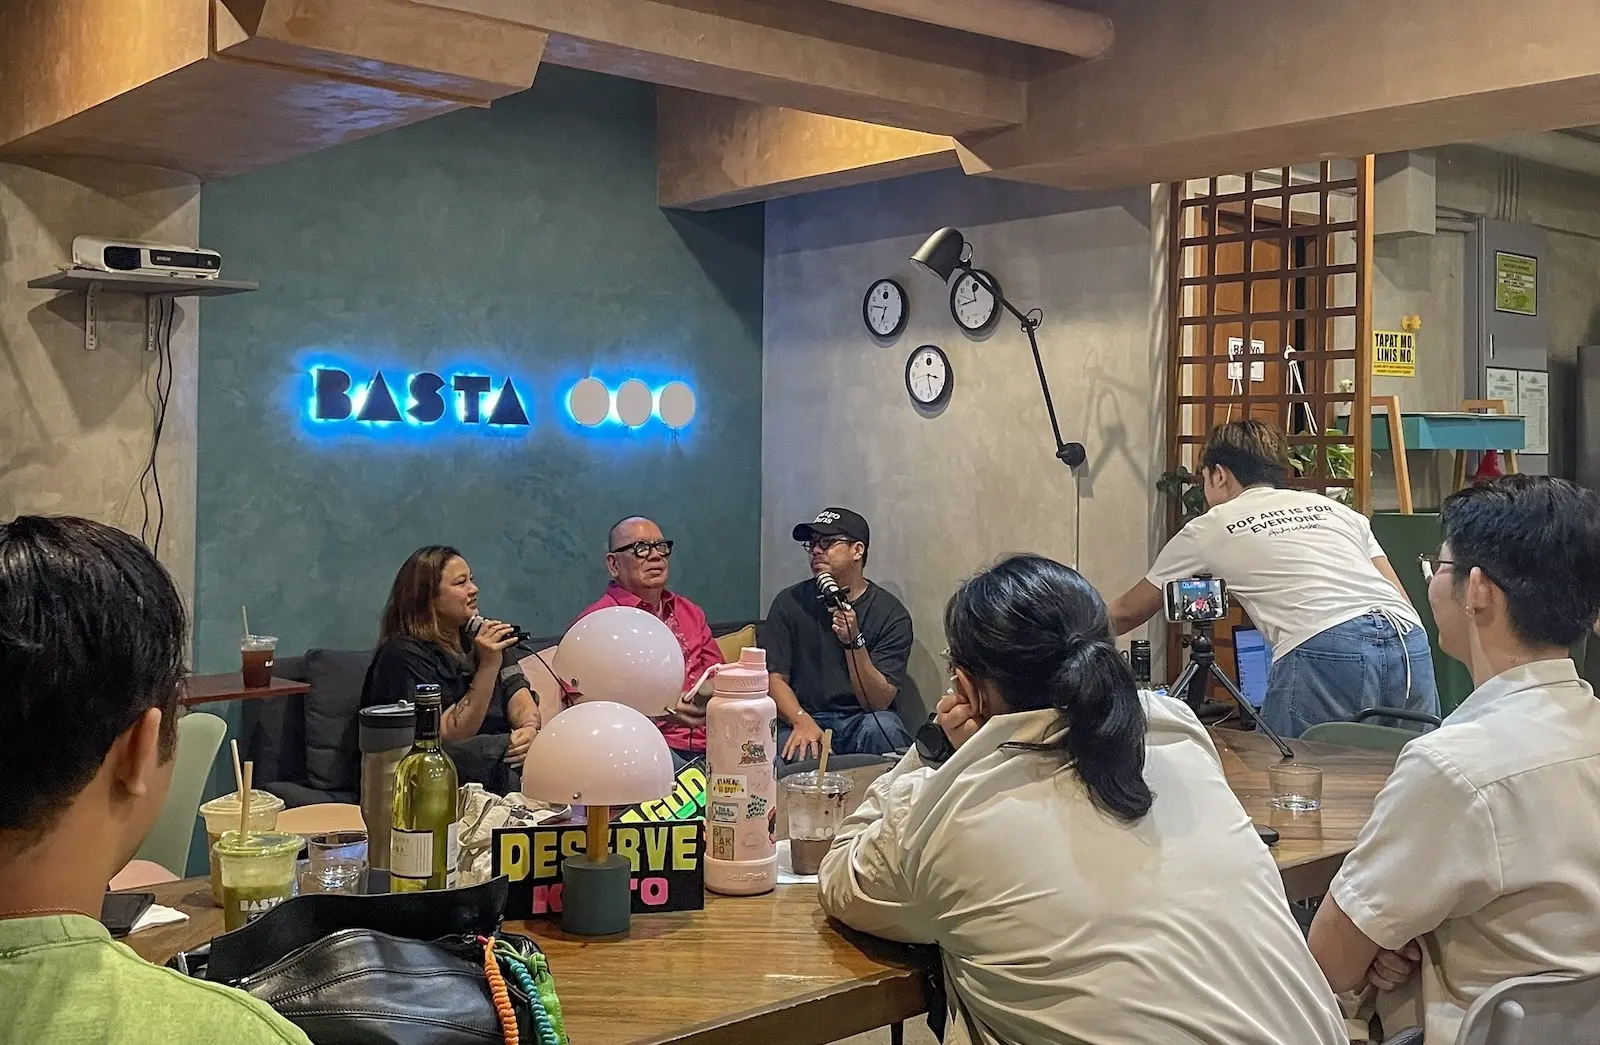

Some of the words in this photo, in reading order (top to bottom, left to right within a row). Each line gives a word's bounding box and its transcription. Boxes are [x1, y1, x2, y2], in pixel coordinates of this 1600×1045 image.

[1375, 333, 1398, 348] TAPAT
[1377, 348, 1398, 362] LINIS
[315, 368, 530, 425] BASTA
[1226, 516, 1256, 534] POP
[1260, 509, 1286, 520] ART
[1288, 507, 1304, 515] IS
[1305, 504, 1334, 513] FOR
[1250, 514, 1324, 534] EVERYONE
[501, 825, 698, 881] DESRVE
